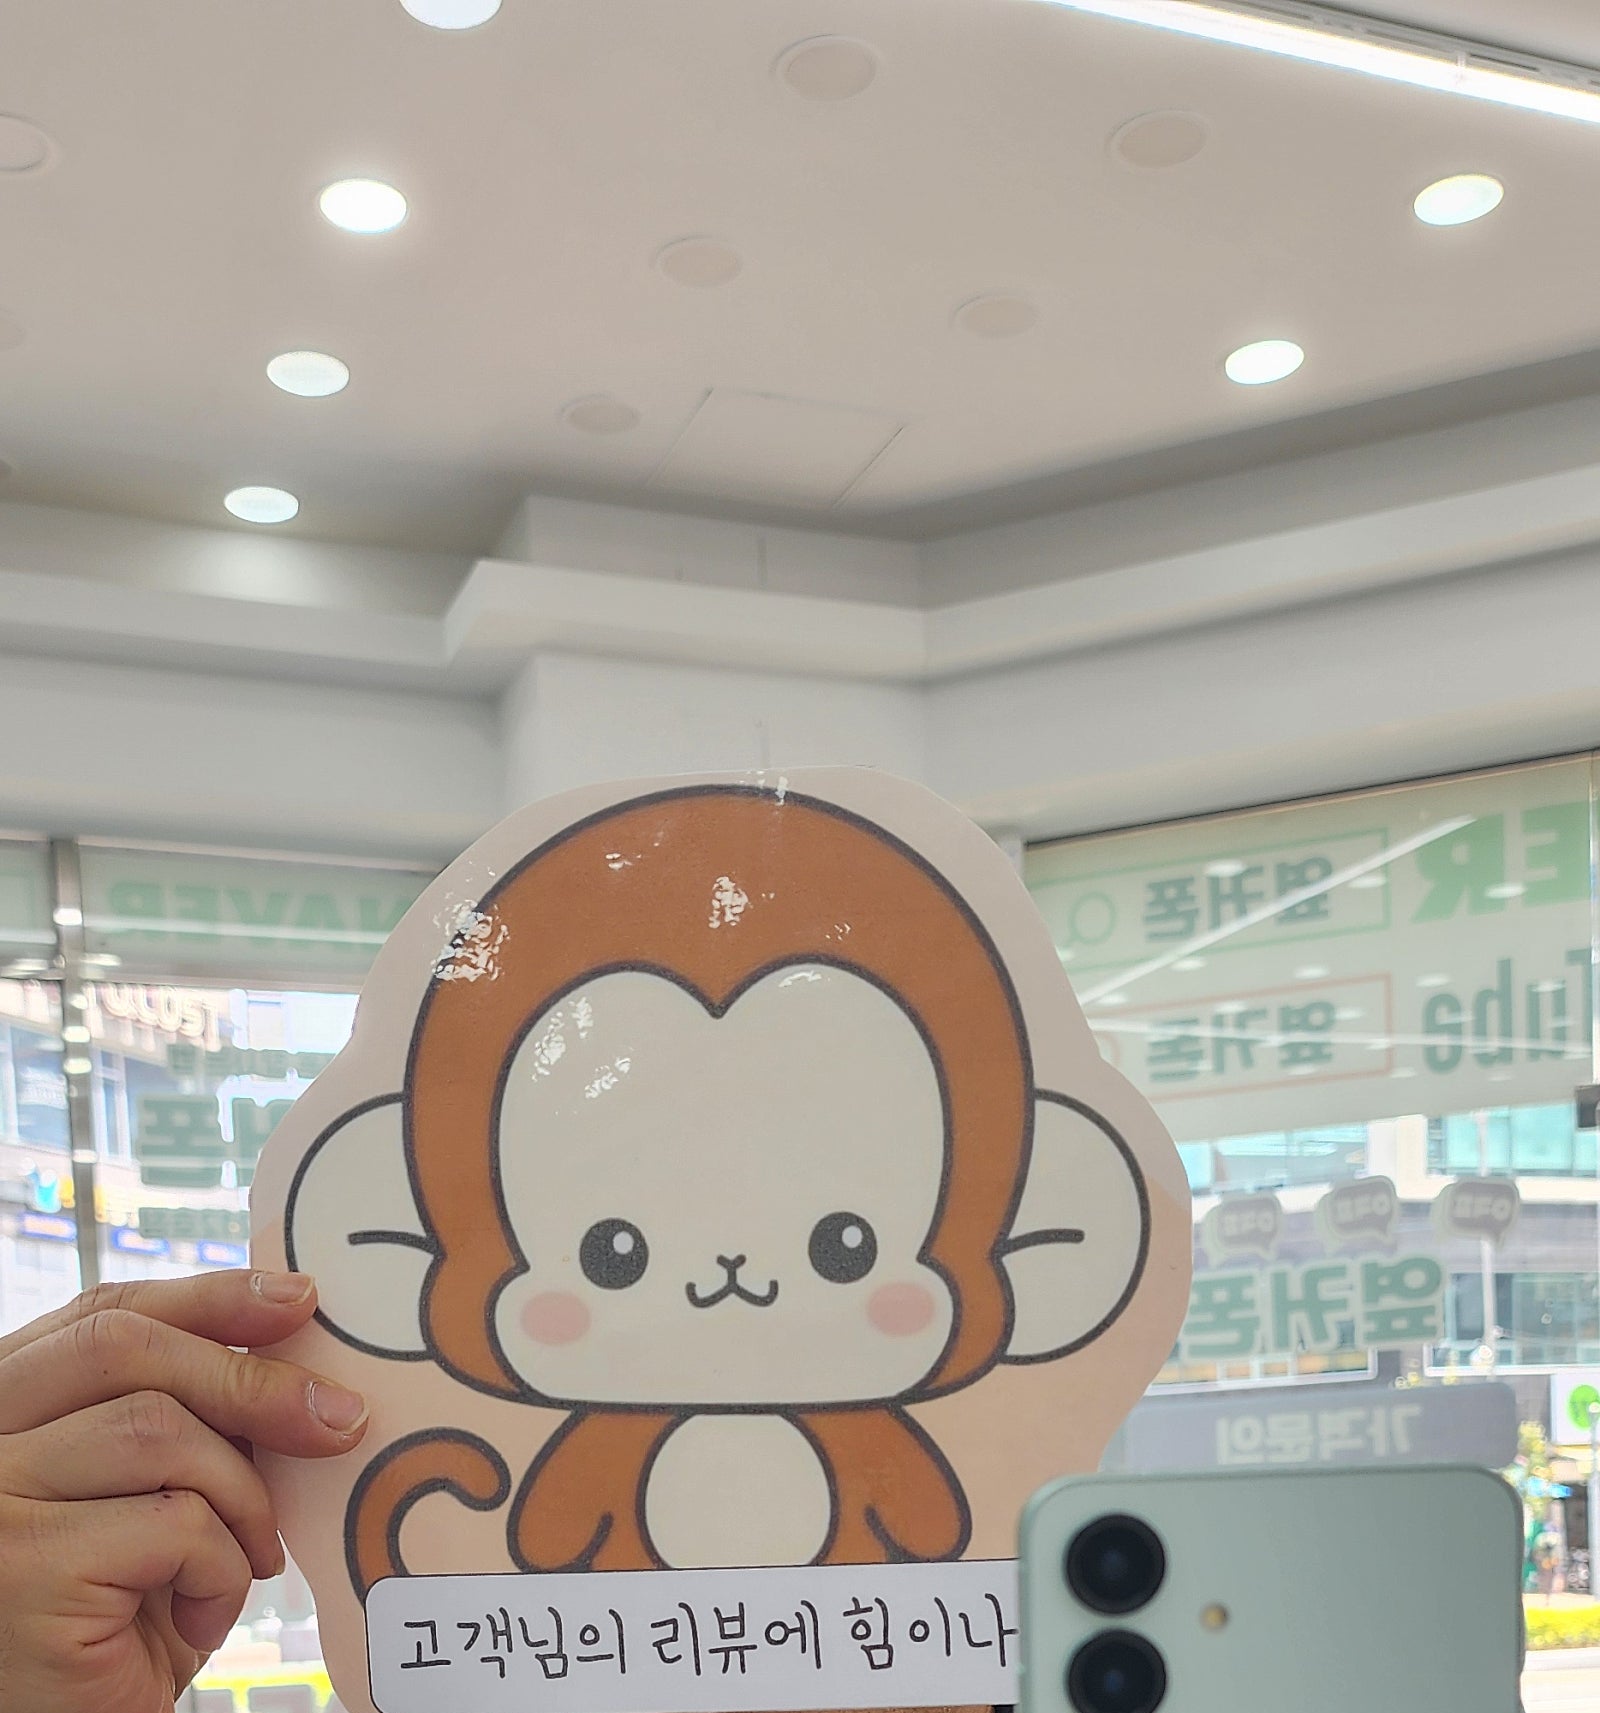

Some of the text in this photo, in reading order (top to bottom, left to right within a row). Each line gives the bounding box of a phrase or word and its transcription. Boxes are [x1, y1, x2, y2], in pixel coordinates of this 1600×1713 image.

[401, 1594, 1015, 1679] 고객님의 리뷰에 힘이나
